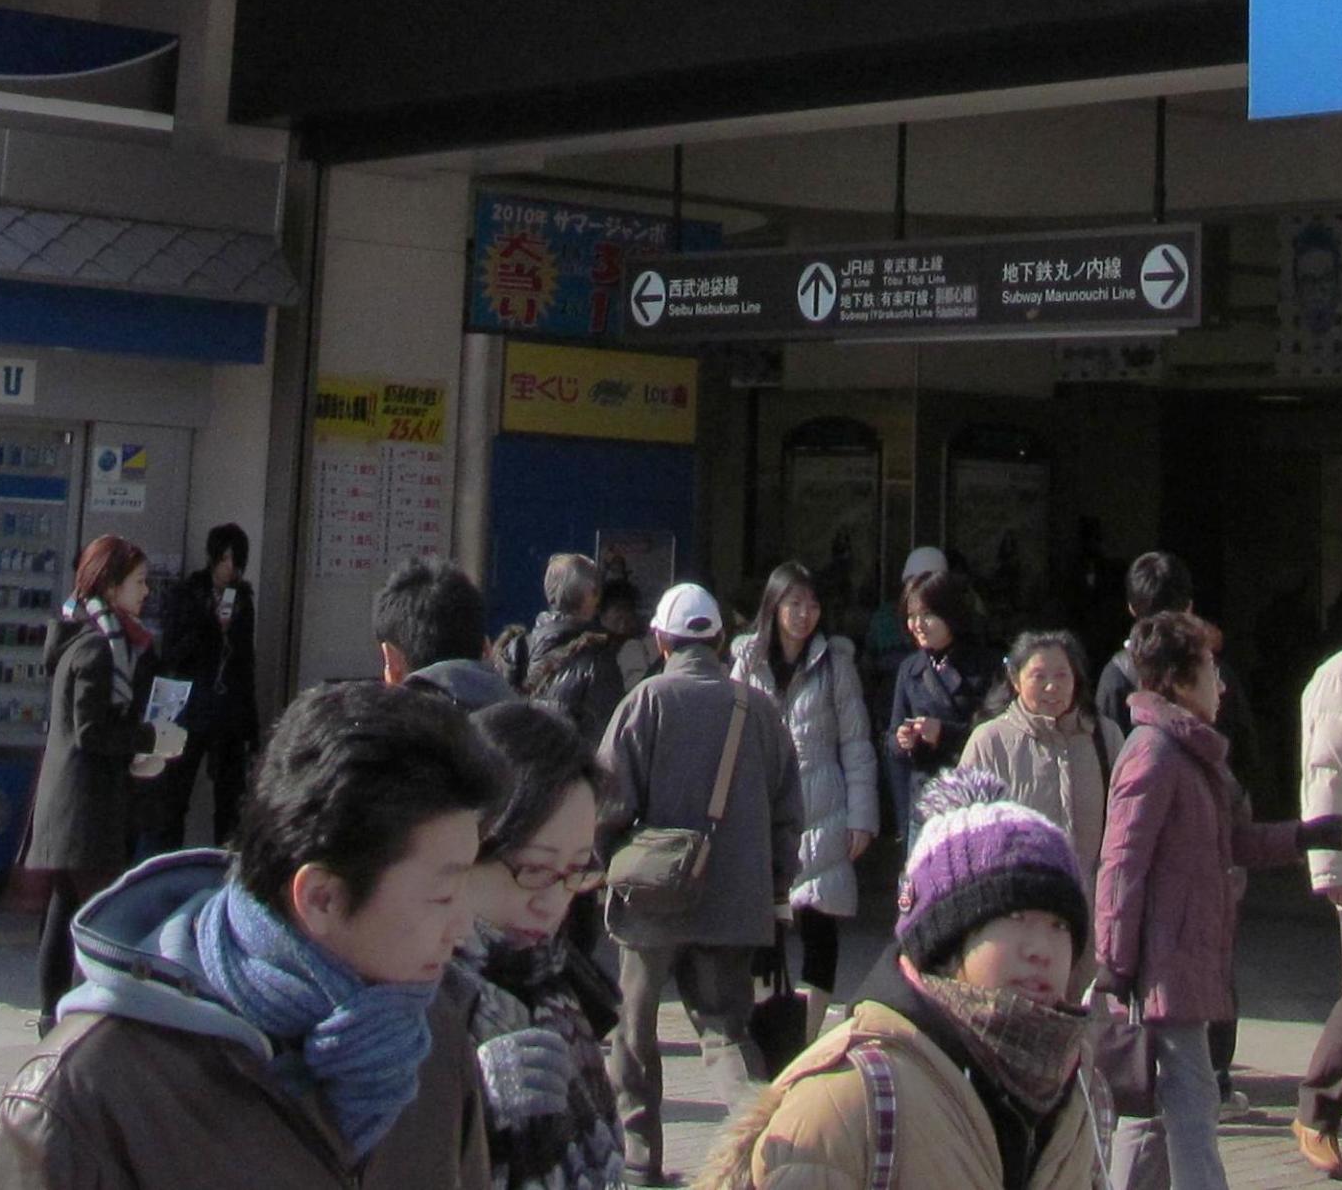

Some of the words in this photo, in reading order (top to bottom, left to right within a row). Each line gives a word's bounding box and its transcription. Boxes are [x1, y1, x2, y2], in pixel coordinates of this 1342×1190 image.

[841, 259, 875, 276] JR線
[1001, 256, 1122, 284] 地下鉄丸ノ内線
[668, 275, 739, 299] 西武池袋線
[1001, 290, 1044, 306] Subway
[1045, 287, 1109, 304] Marunouchi
[1112, 286, 1137, 301] Line
[668, 304, 693, 317] Seibu
[695, 302, 739, 316] Ikebukuro
[741, 300, 762, 315] Line
